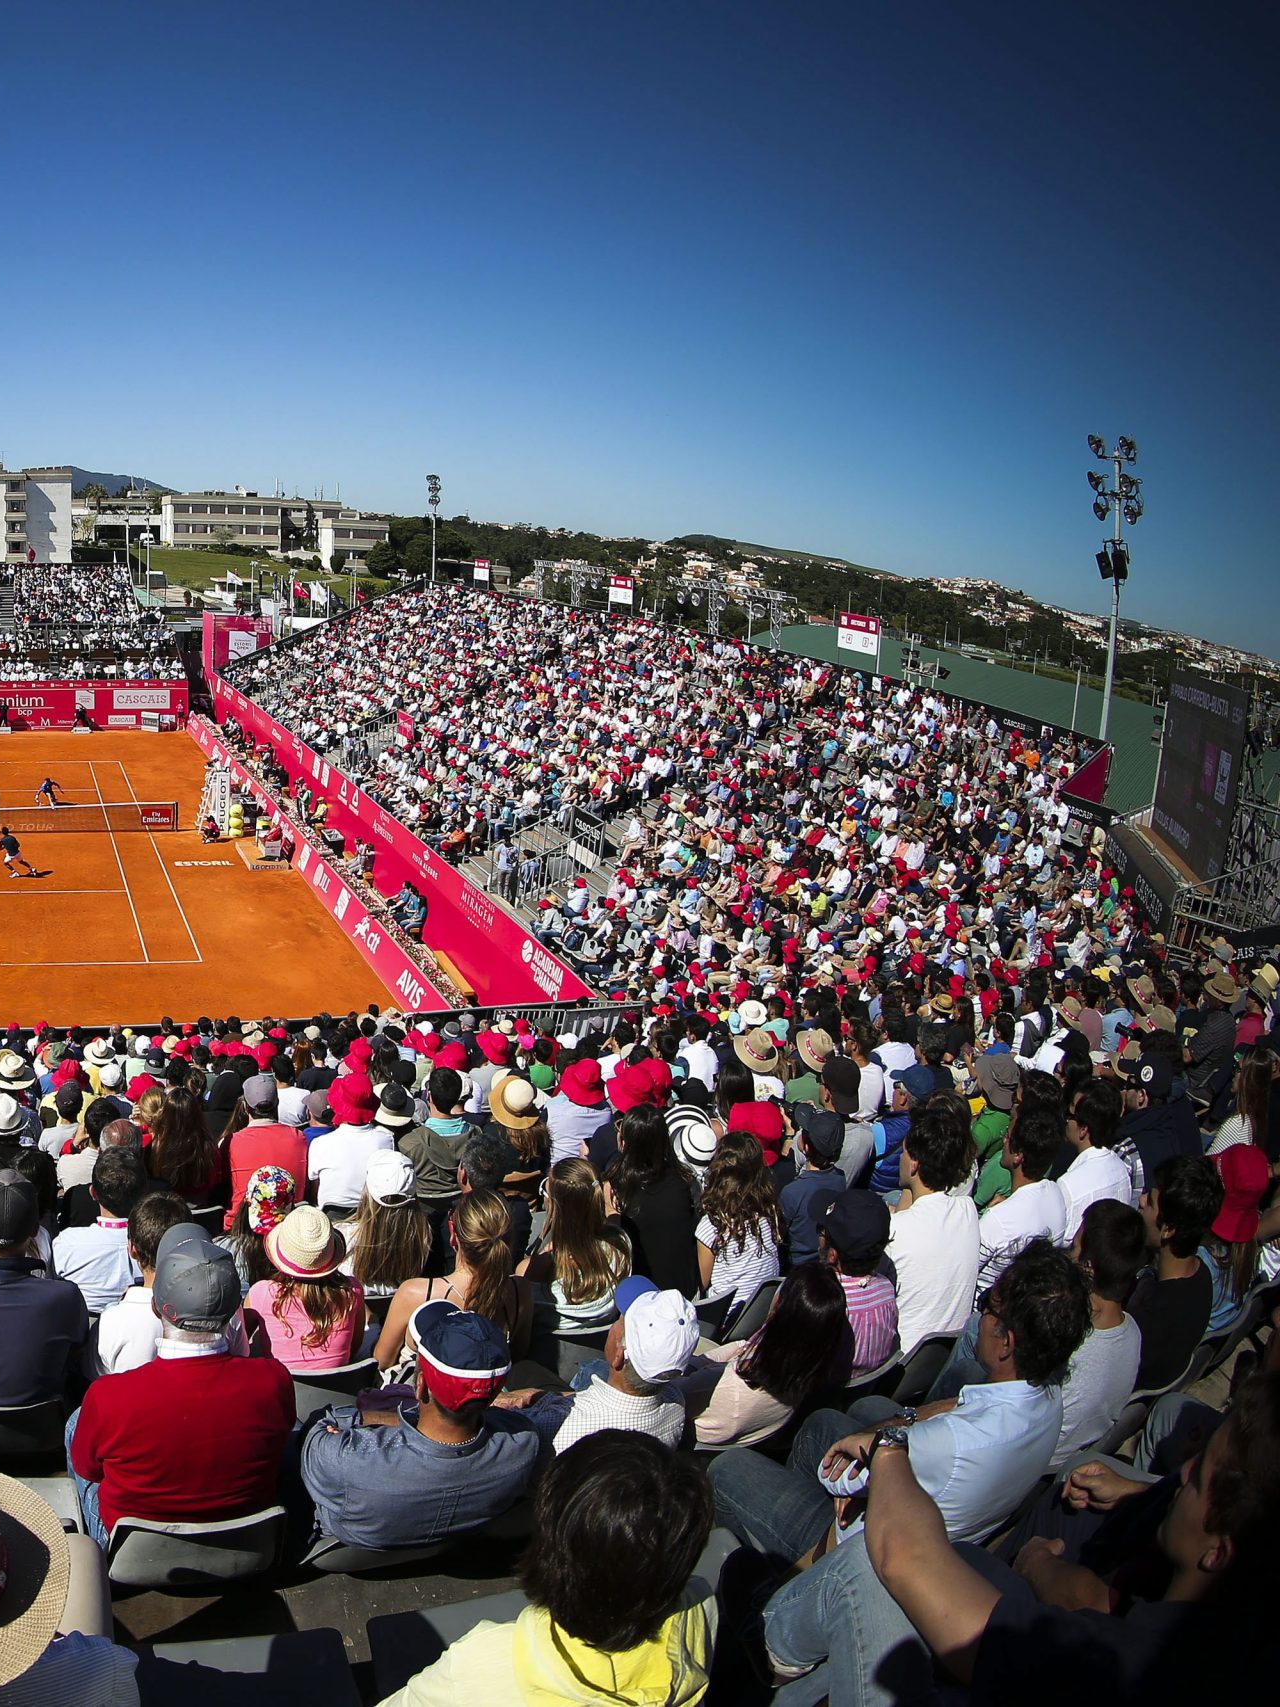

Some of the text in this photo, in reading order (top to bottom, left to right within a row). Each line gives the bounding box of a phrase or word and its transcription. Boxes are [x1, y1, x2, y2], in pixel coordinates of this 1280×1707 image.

[17, 708, 33, 716] bcp
[117, 695, 167, 704] CASCAIS
[40, 717, 51, 726] M
[219, 778, 227, 832] PEUGEOT
[19, 823, 55, 832] TOUR
[461, 891, 494, 926] MIRAGEM
[1134, 873, 1163, 925] CASCAIS
[532, 947, 564, 987] ACADEMIA
[534, 967, 560, 1001] CHAMPS
[395, 969, 425, 1009] AVIS
